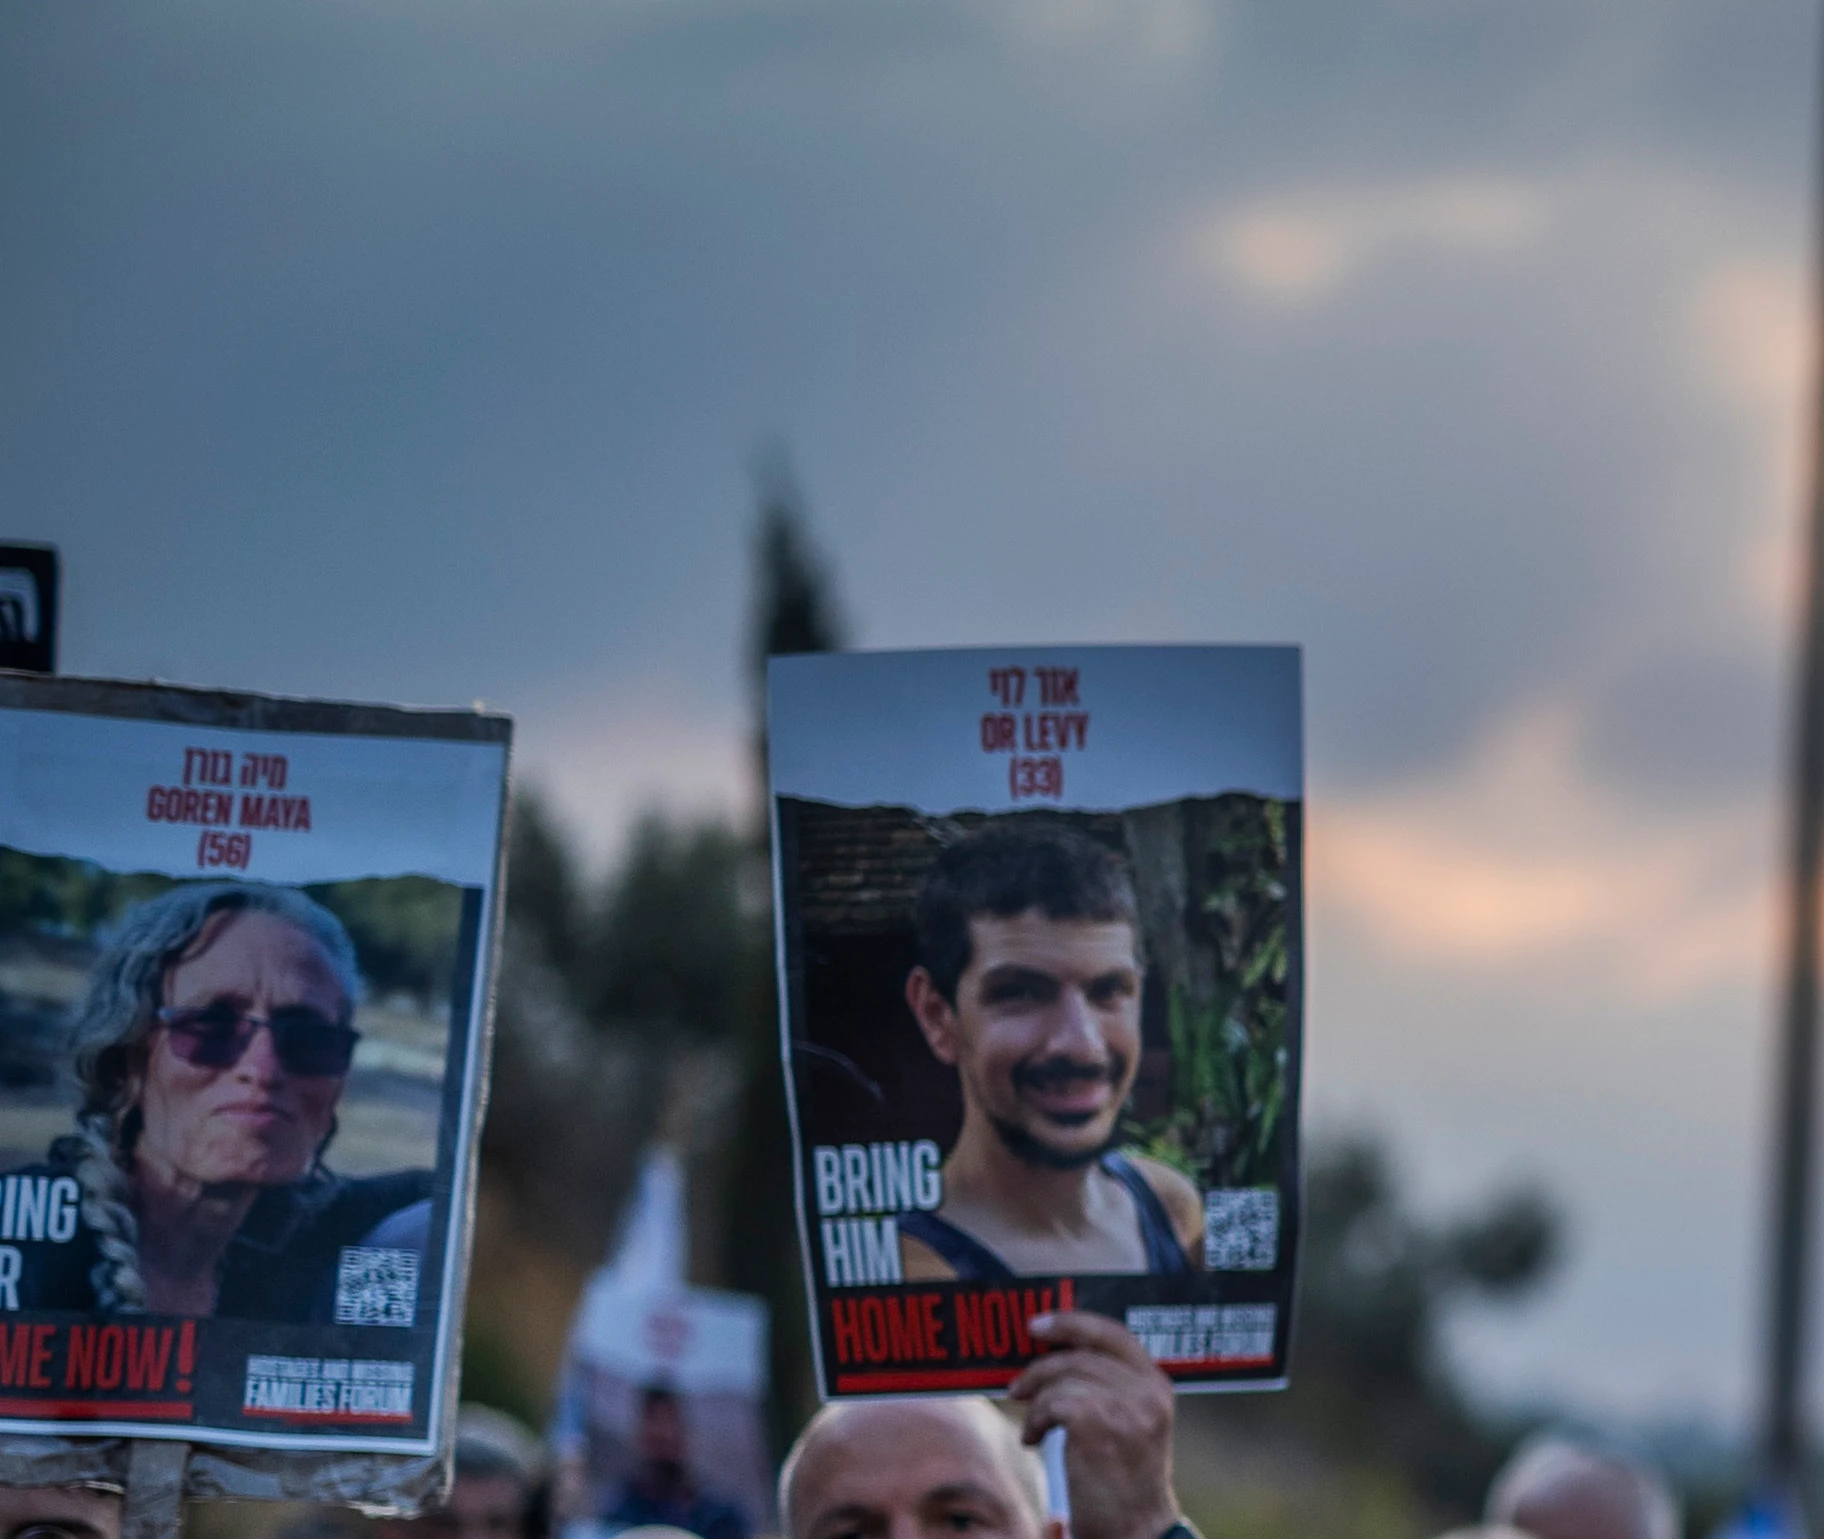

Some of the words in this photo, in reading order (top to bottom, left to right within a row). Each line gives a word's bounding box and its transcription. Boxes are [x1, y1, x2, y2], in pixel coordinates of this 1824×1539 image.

[981, 712, 1016, 753] OR
[1022, 711, 1089, 752] LEVY
[147, 785, 233, 827] GOREN
[240, 793, 312, 833] MAYA
[1009, 755, 1063, 800] (33)
[198, 830, 252, 872] (56)
[0, 1175, 79, 1244] ING
[814, 1139, 942, 1216] BRING
[821, 1216, 901, 1287] HIM
[65, 1320, 198, 1394] NOW!
[831, 1293, 946, 1364] HOME
